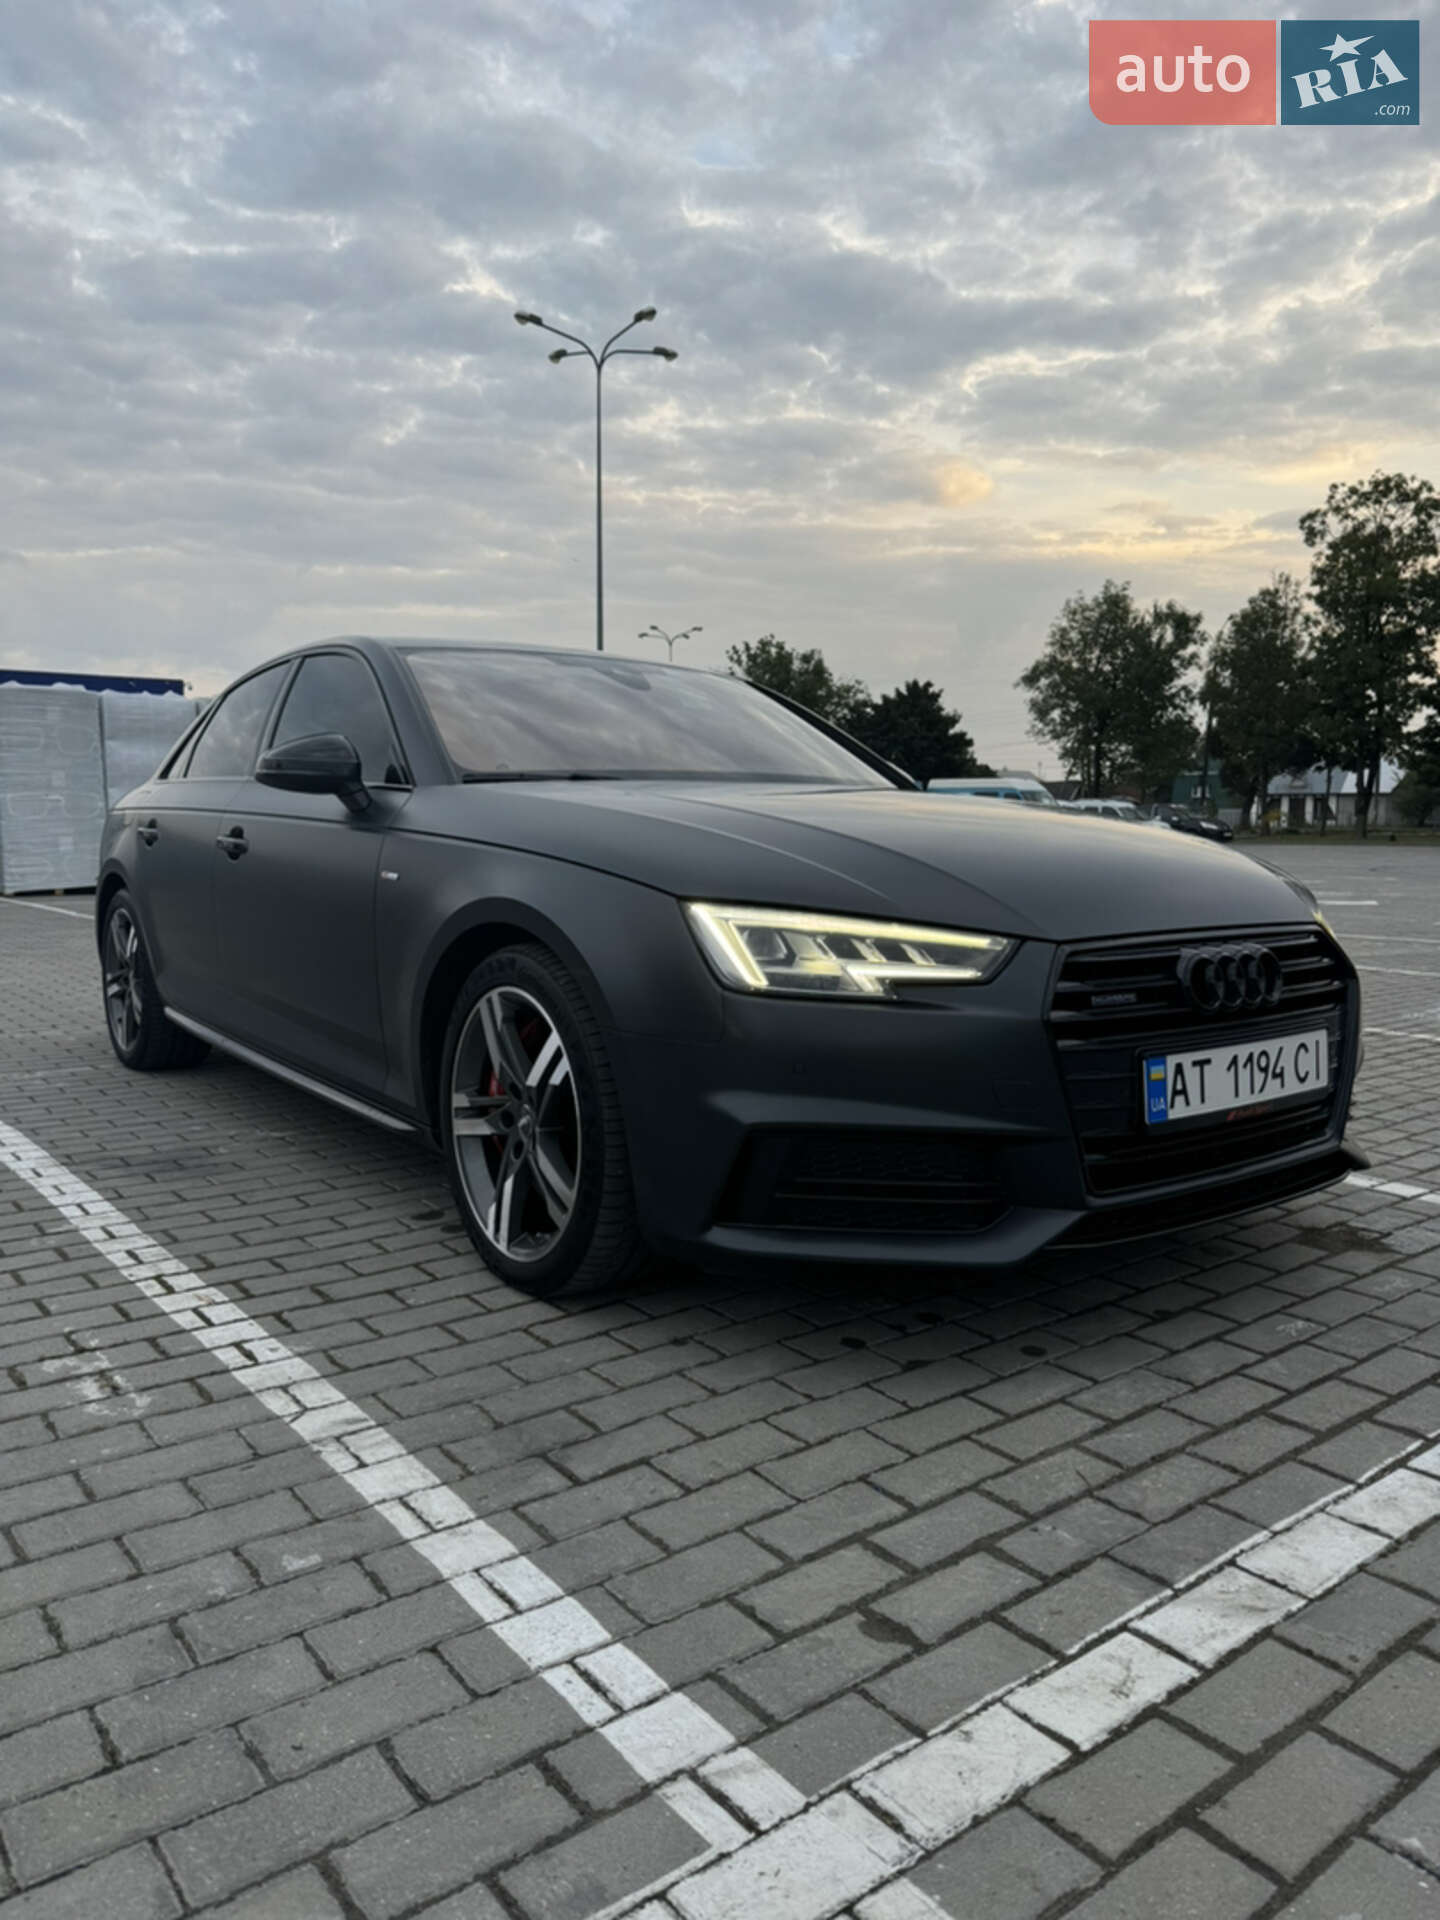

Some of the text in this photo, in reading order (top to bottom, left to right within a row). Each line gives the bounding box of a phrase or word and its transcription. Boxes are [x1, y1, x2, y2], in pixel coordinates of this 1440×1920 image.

[1169, 1039, 1320, 1110] AT 1194 CI
[1150, 1096, 1166, 1112] UA
